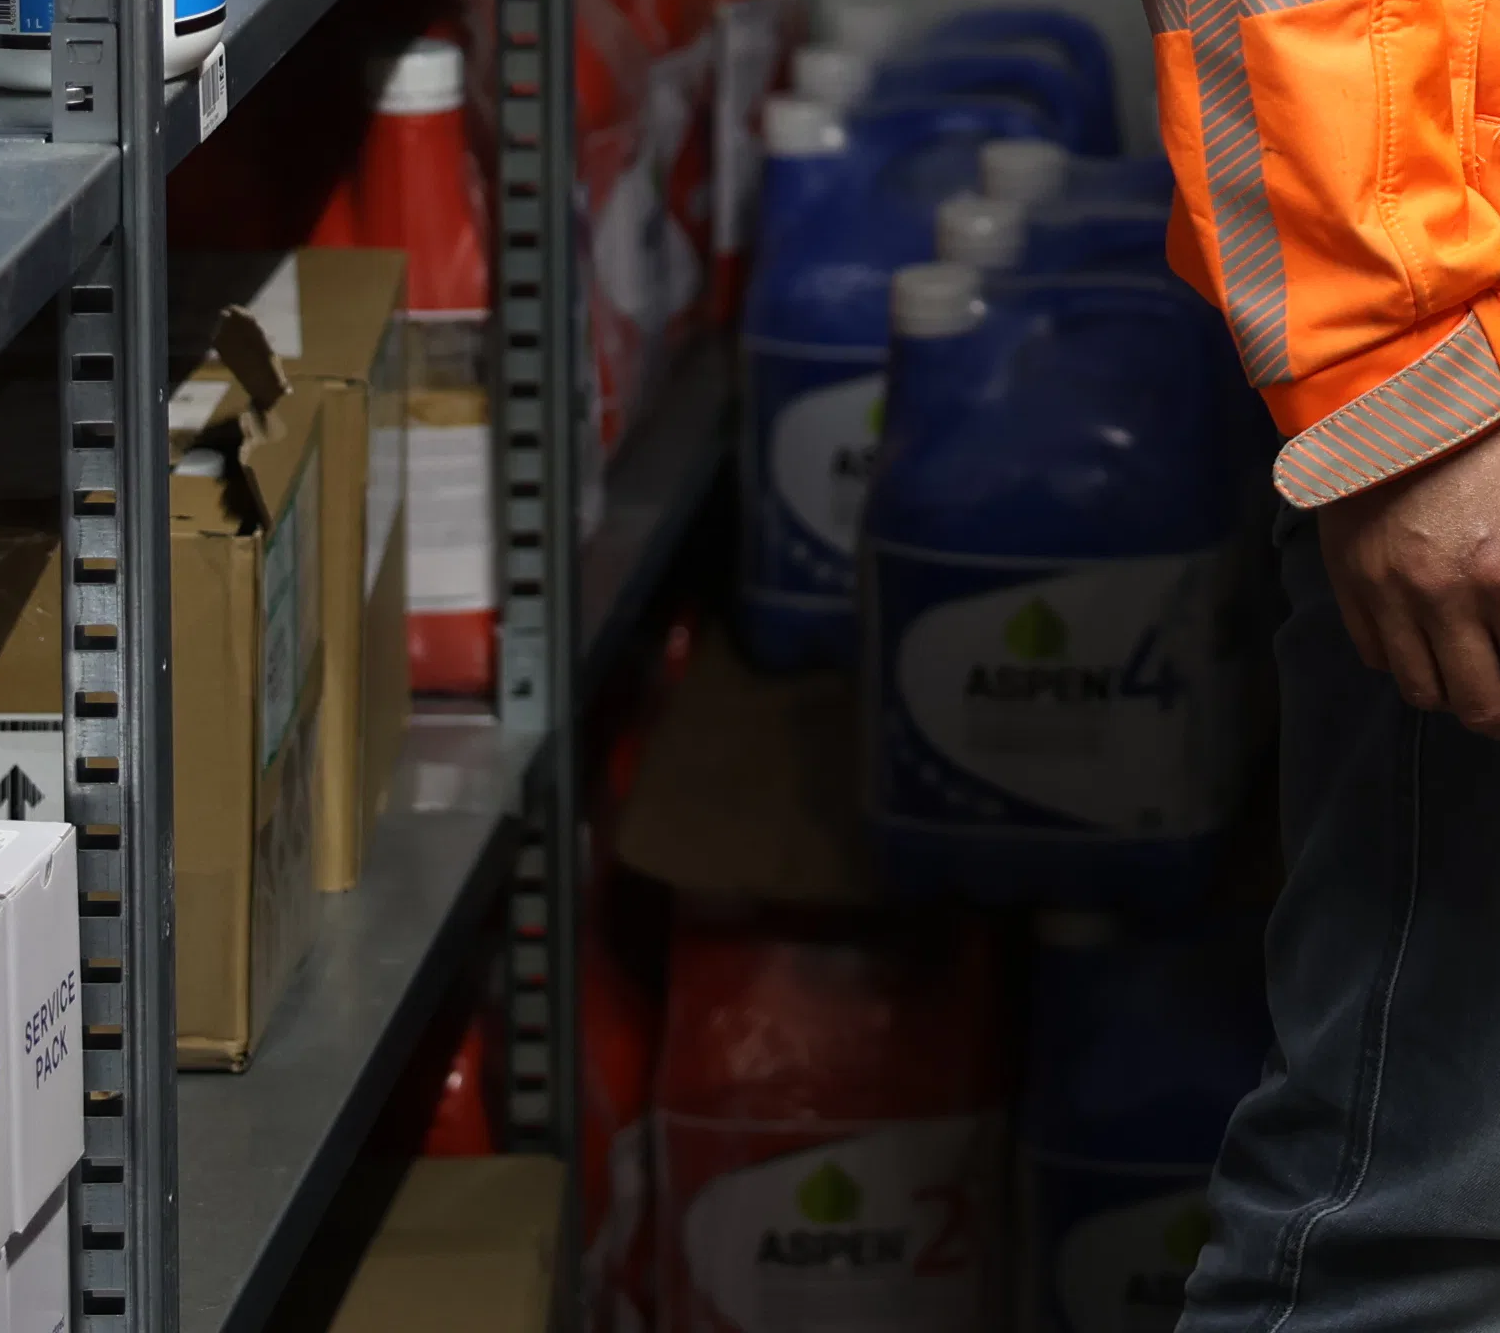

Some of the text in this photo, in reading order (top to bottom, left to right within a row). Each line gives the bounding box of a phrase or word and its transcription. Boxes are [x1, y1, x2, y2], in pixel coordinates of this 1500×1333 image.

[1121, 625, 1186, 712] 4
[24, 969, 76, 1055] SERVICE
[35, 1024, 69, 1090] PACK
[912, 1184, 968, 1276] 2
